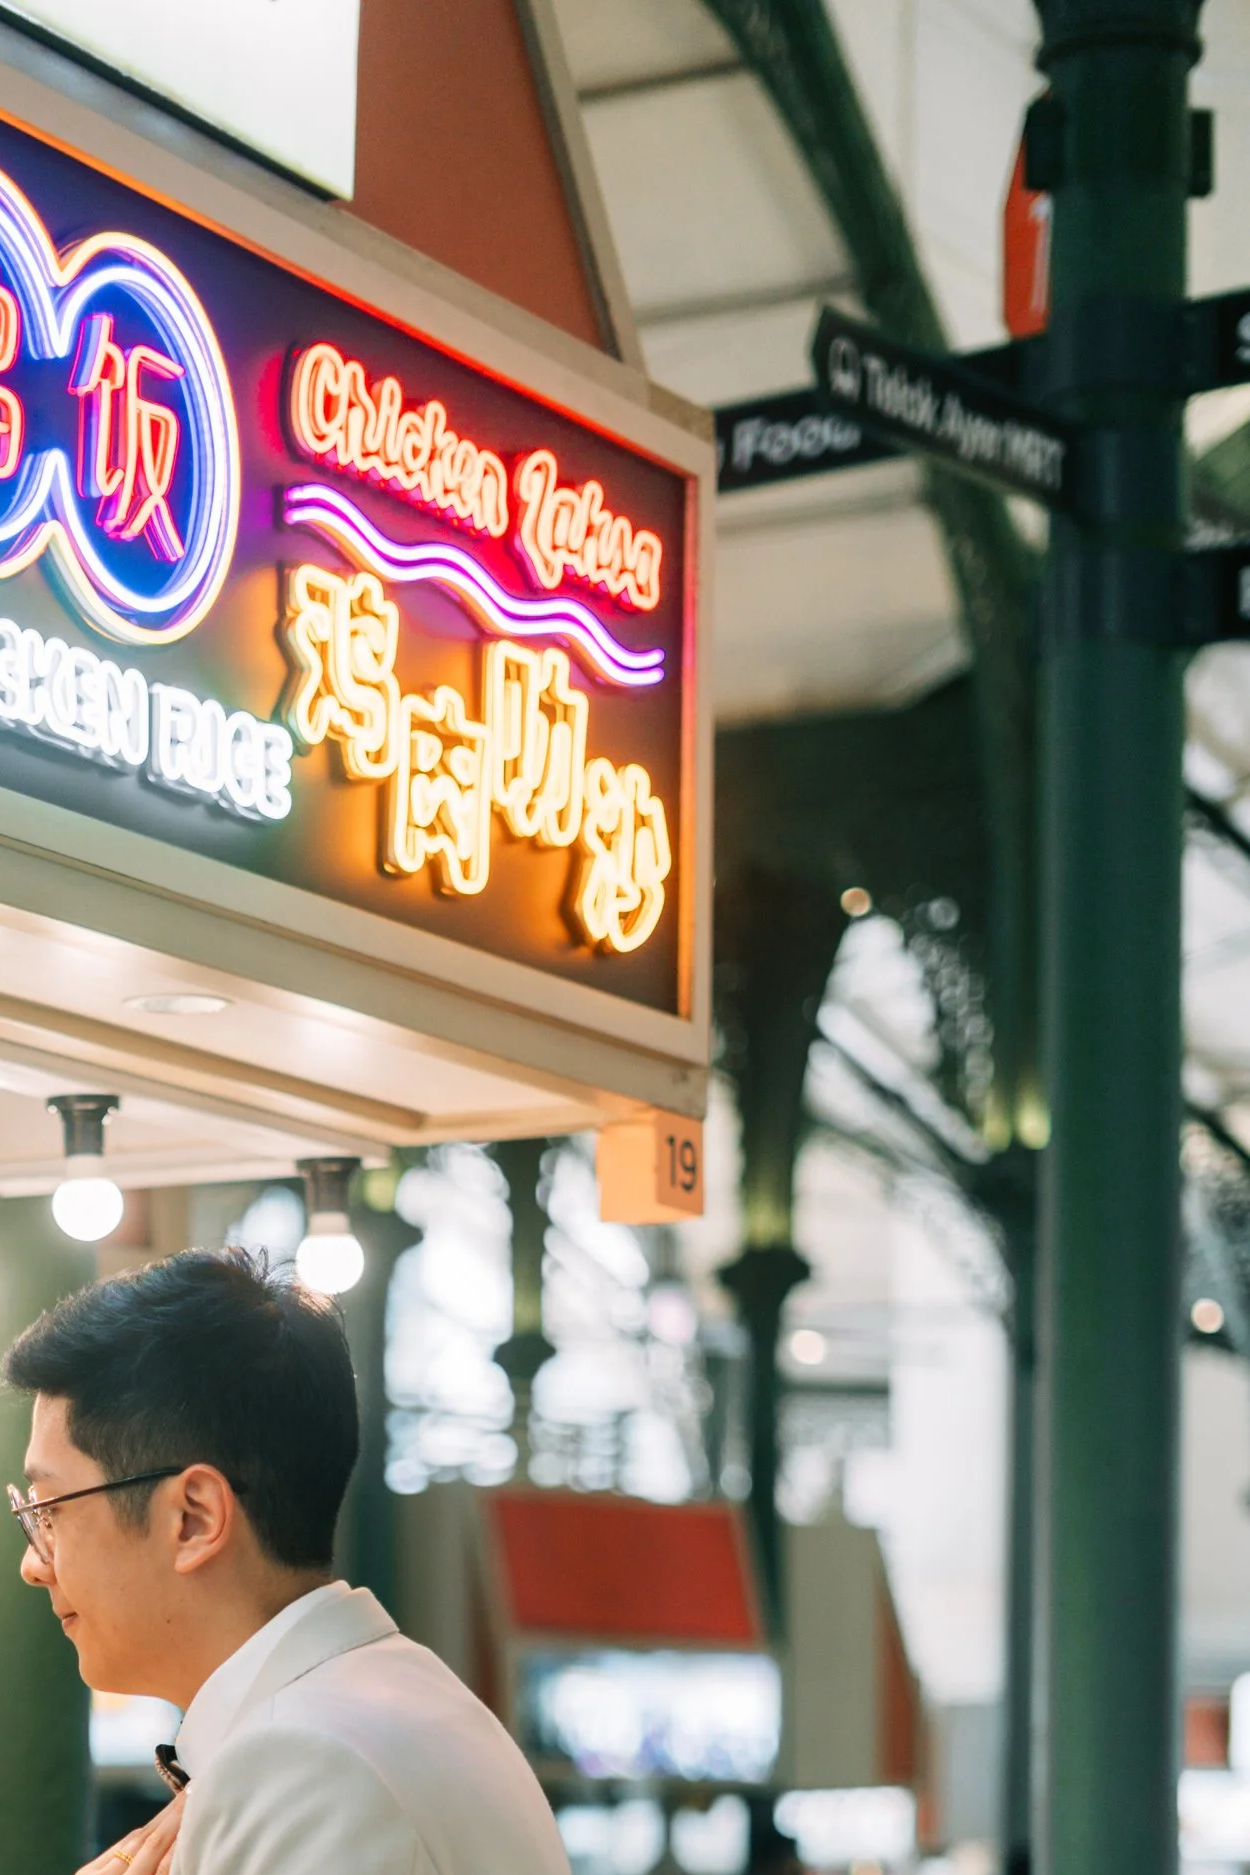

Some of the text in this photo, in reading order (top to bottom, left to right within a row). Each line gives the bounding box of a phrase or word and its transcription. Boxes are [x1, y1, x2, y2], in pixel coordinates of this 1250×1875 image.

[292, 341, 509, 538] Chicken
[150, 682, 293, 822] RICE
[665, 1135, 698, 1195] 19
